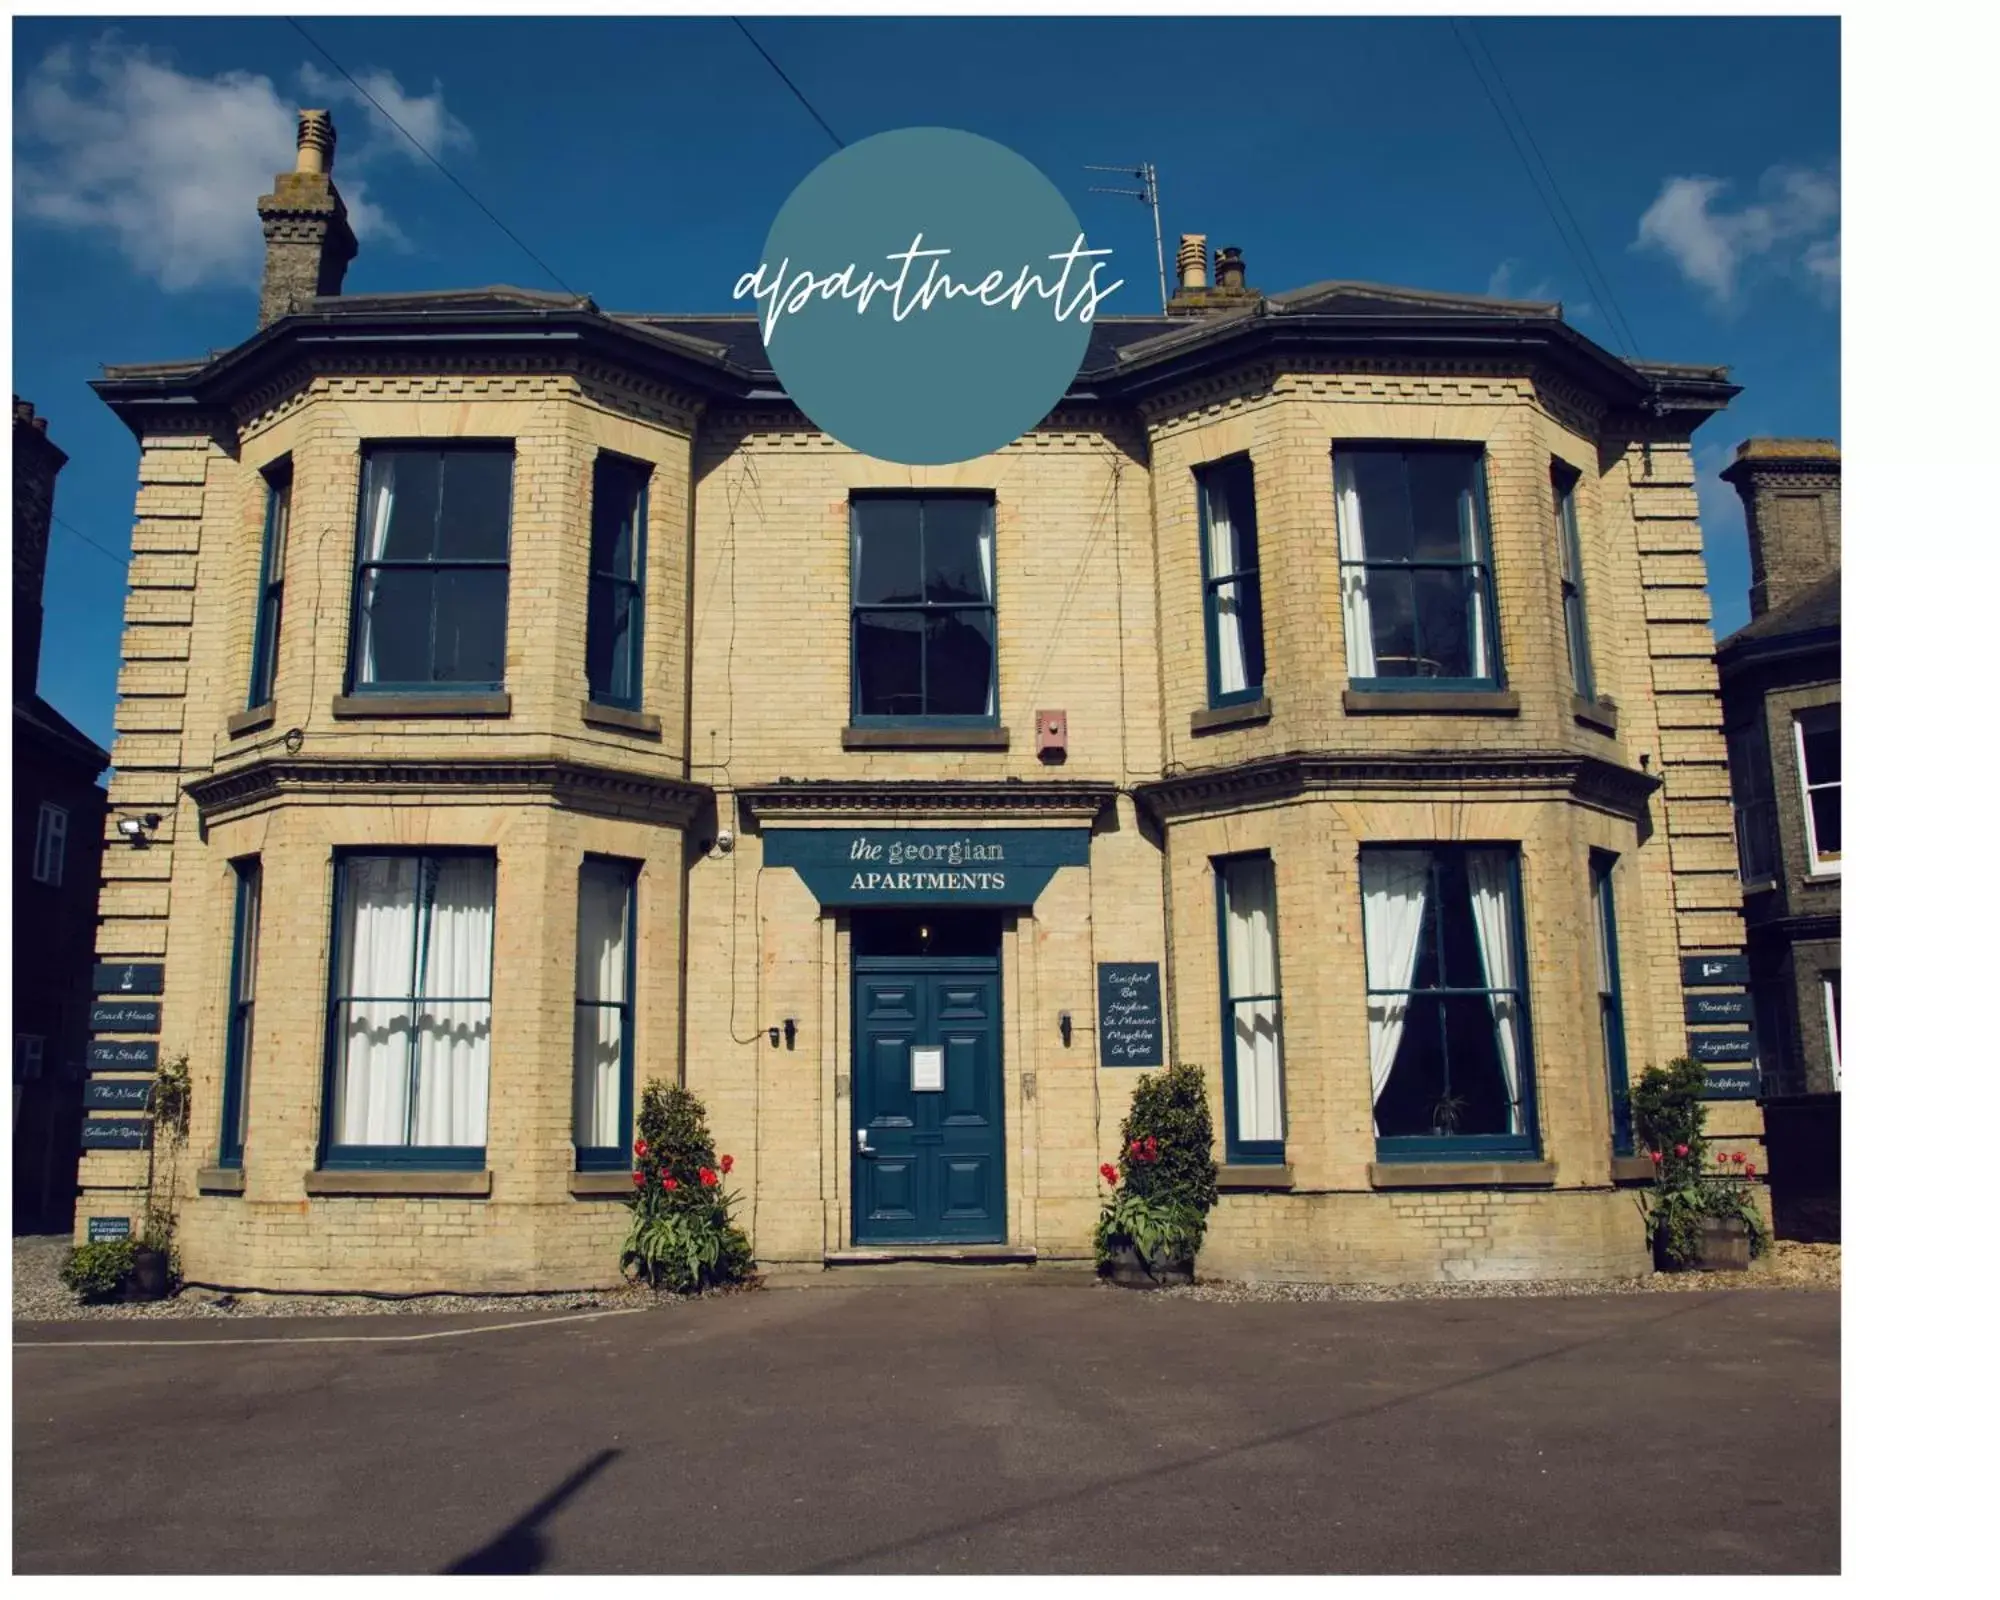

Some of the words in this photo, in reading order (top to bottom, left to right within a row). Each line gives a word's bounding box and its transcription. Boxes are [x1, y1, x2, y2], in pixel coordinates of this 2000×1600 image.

[850, 837, 883, 861] the
[888, 838, 1005, 864] georgian
[850, 872, 1006, 890] APARTMENTS
[94, 1009, 124, 1021] Coach
[93, 1048, 114, 1061] The
[115, 1048, 149, 1061] Stable
[93, 1086, 114, 1098] The
